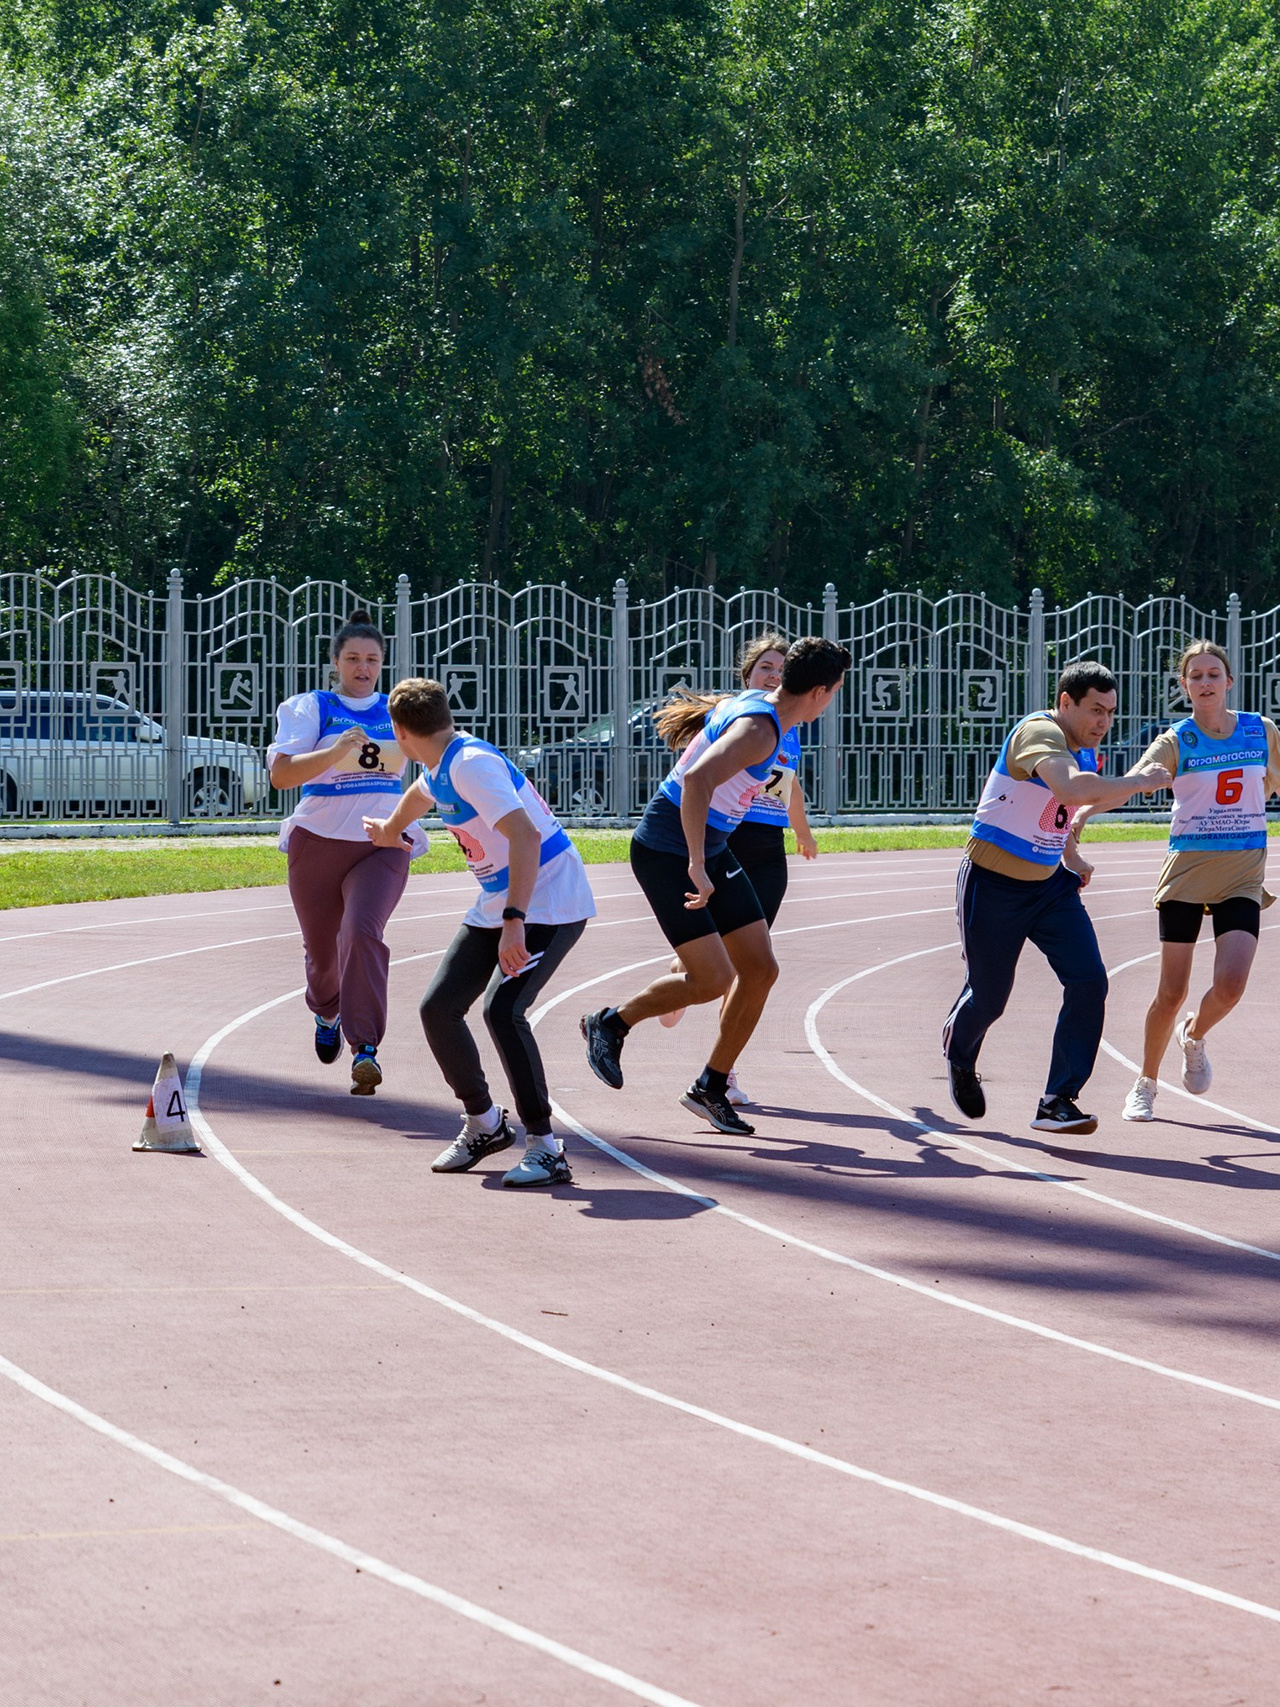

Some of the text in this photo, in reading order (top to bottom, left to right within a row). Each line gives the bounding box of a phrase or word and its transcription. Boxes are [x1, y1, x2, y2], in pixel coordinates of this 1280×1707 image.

[358, 742, 380, 770] 8
[765, 770, 783, 793] 7
[1216, 769, 1244, 805] 6
[1055, 804, 1068, 829] 6
[166, 1090, 186, 1122] 4
